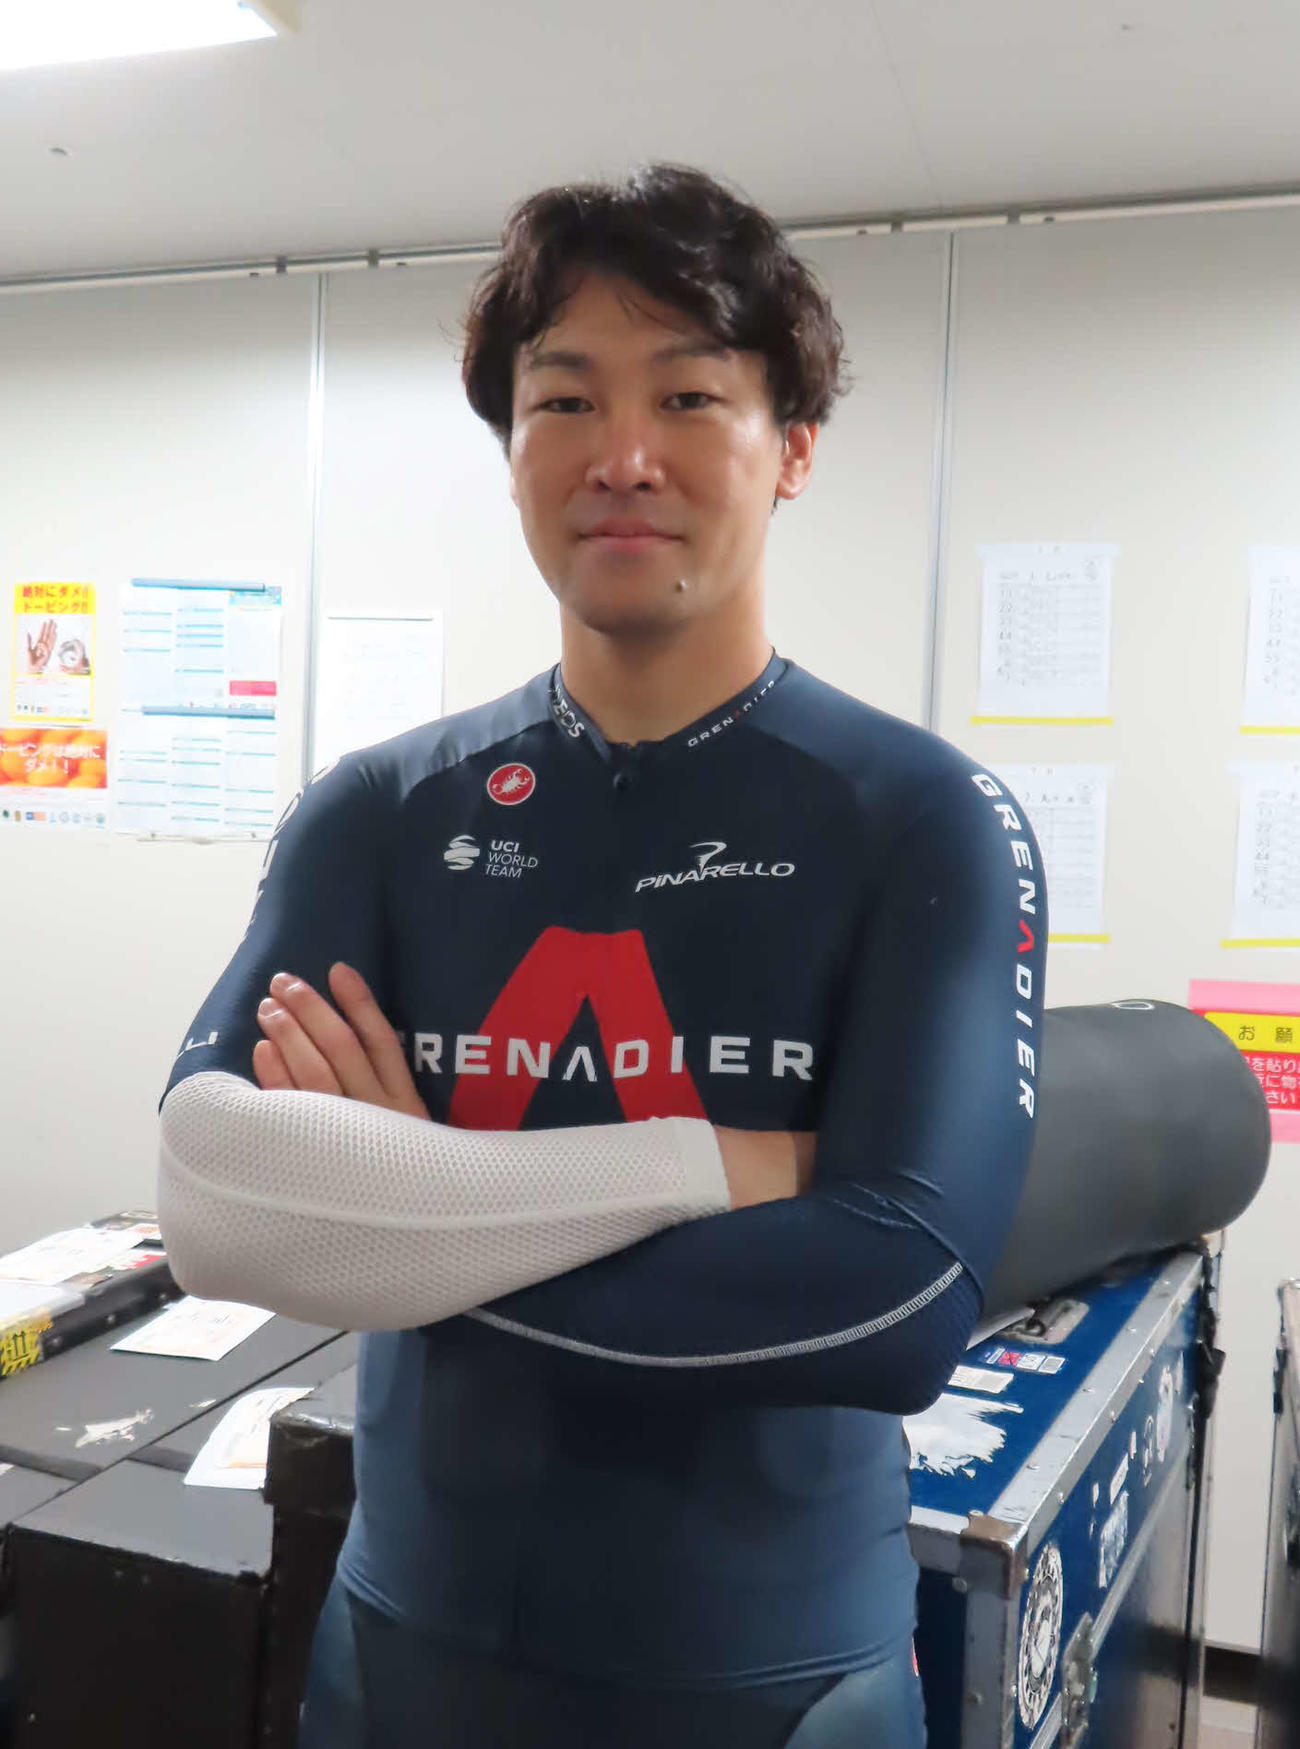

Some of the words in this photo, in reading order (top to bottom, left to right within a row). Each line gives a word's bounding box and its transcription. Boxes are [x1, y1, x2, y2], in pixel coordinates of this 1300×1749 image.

[490, 839, 520, 853] UCI
[485, 863, 523, 878] TEAM
[488, 851, 539, 868] WORLD
[635, 860, 796, 893] PINARELLO
[972, 773, 1037, 1119] GRENADIER
[396, 1030, 813, 1081] RENADIER
